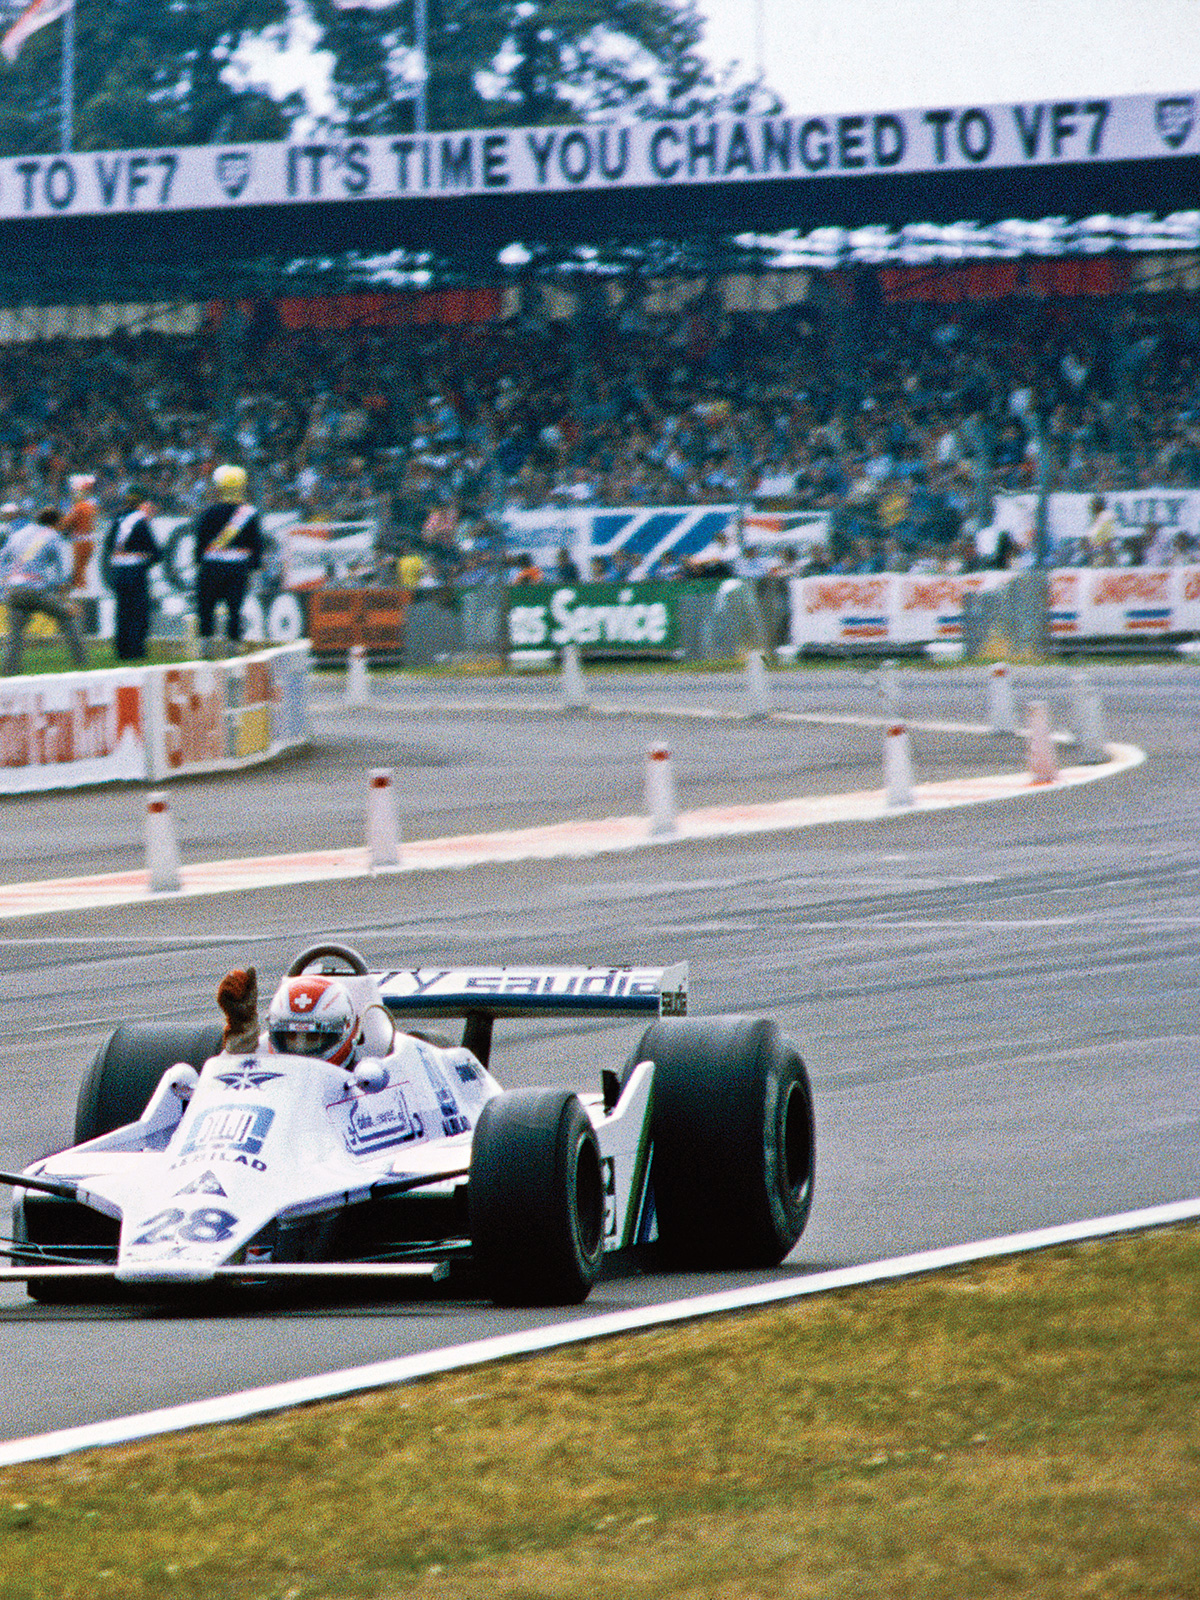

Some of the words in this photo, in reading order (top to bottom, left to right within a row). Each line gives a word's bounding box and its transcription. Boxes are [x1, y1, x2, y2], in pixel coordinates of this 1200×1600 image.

[391, 135, 509, 189] TIME
[527, 128, 630, 184] YOU
[649, 113, 906, 179] CHANGED
[924, 108, 994, 164] TO
[1014, 100, 1111, 159] VF7
[15, 158, 77, 210] TO
[96, 154, 179, 207] VF7
[129, 1206, 240, 1246] 28
